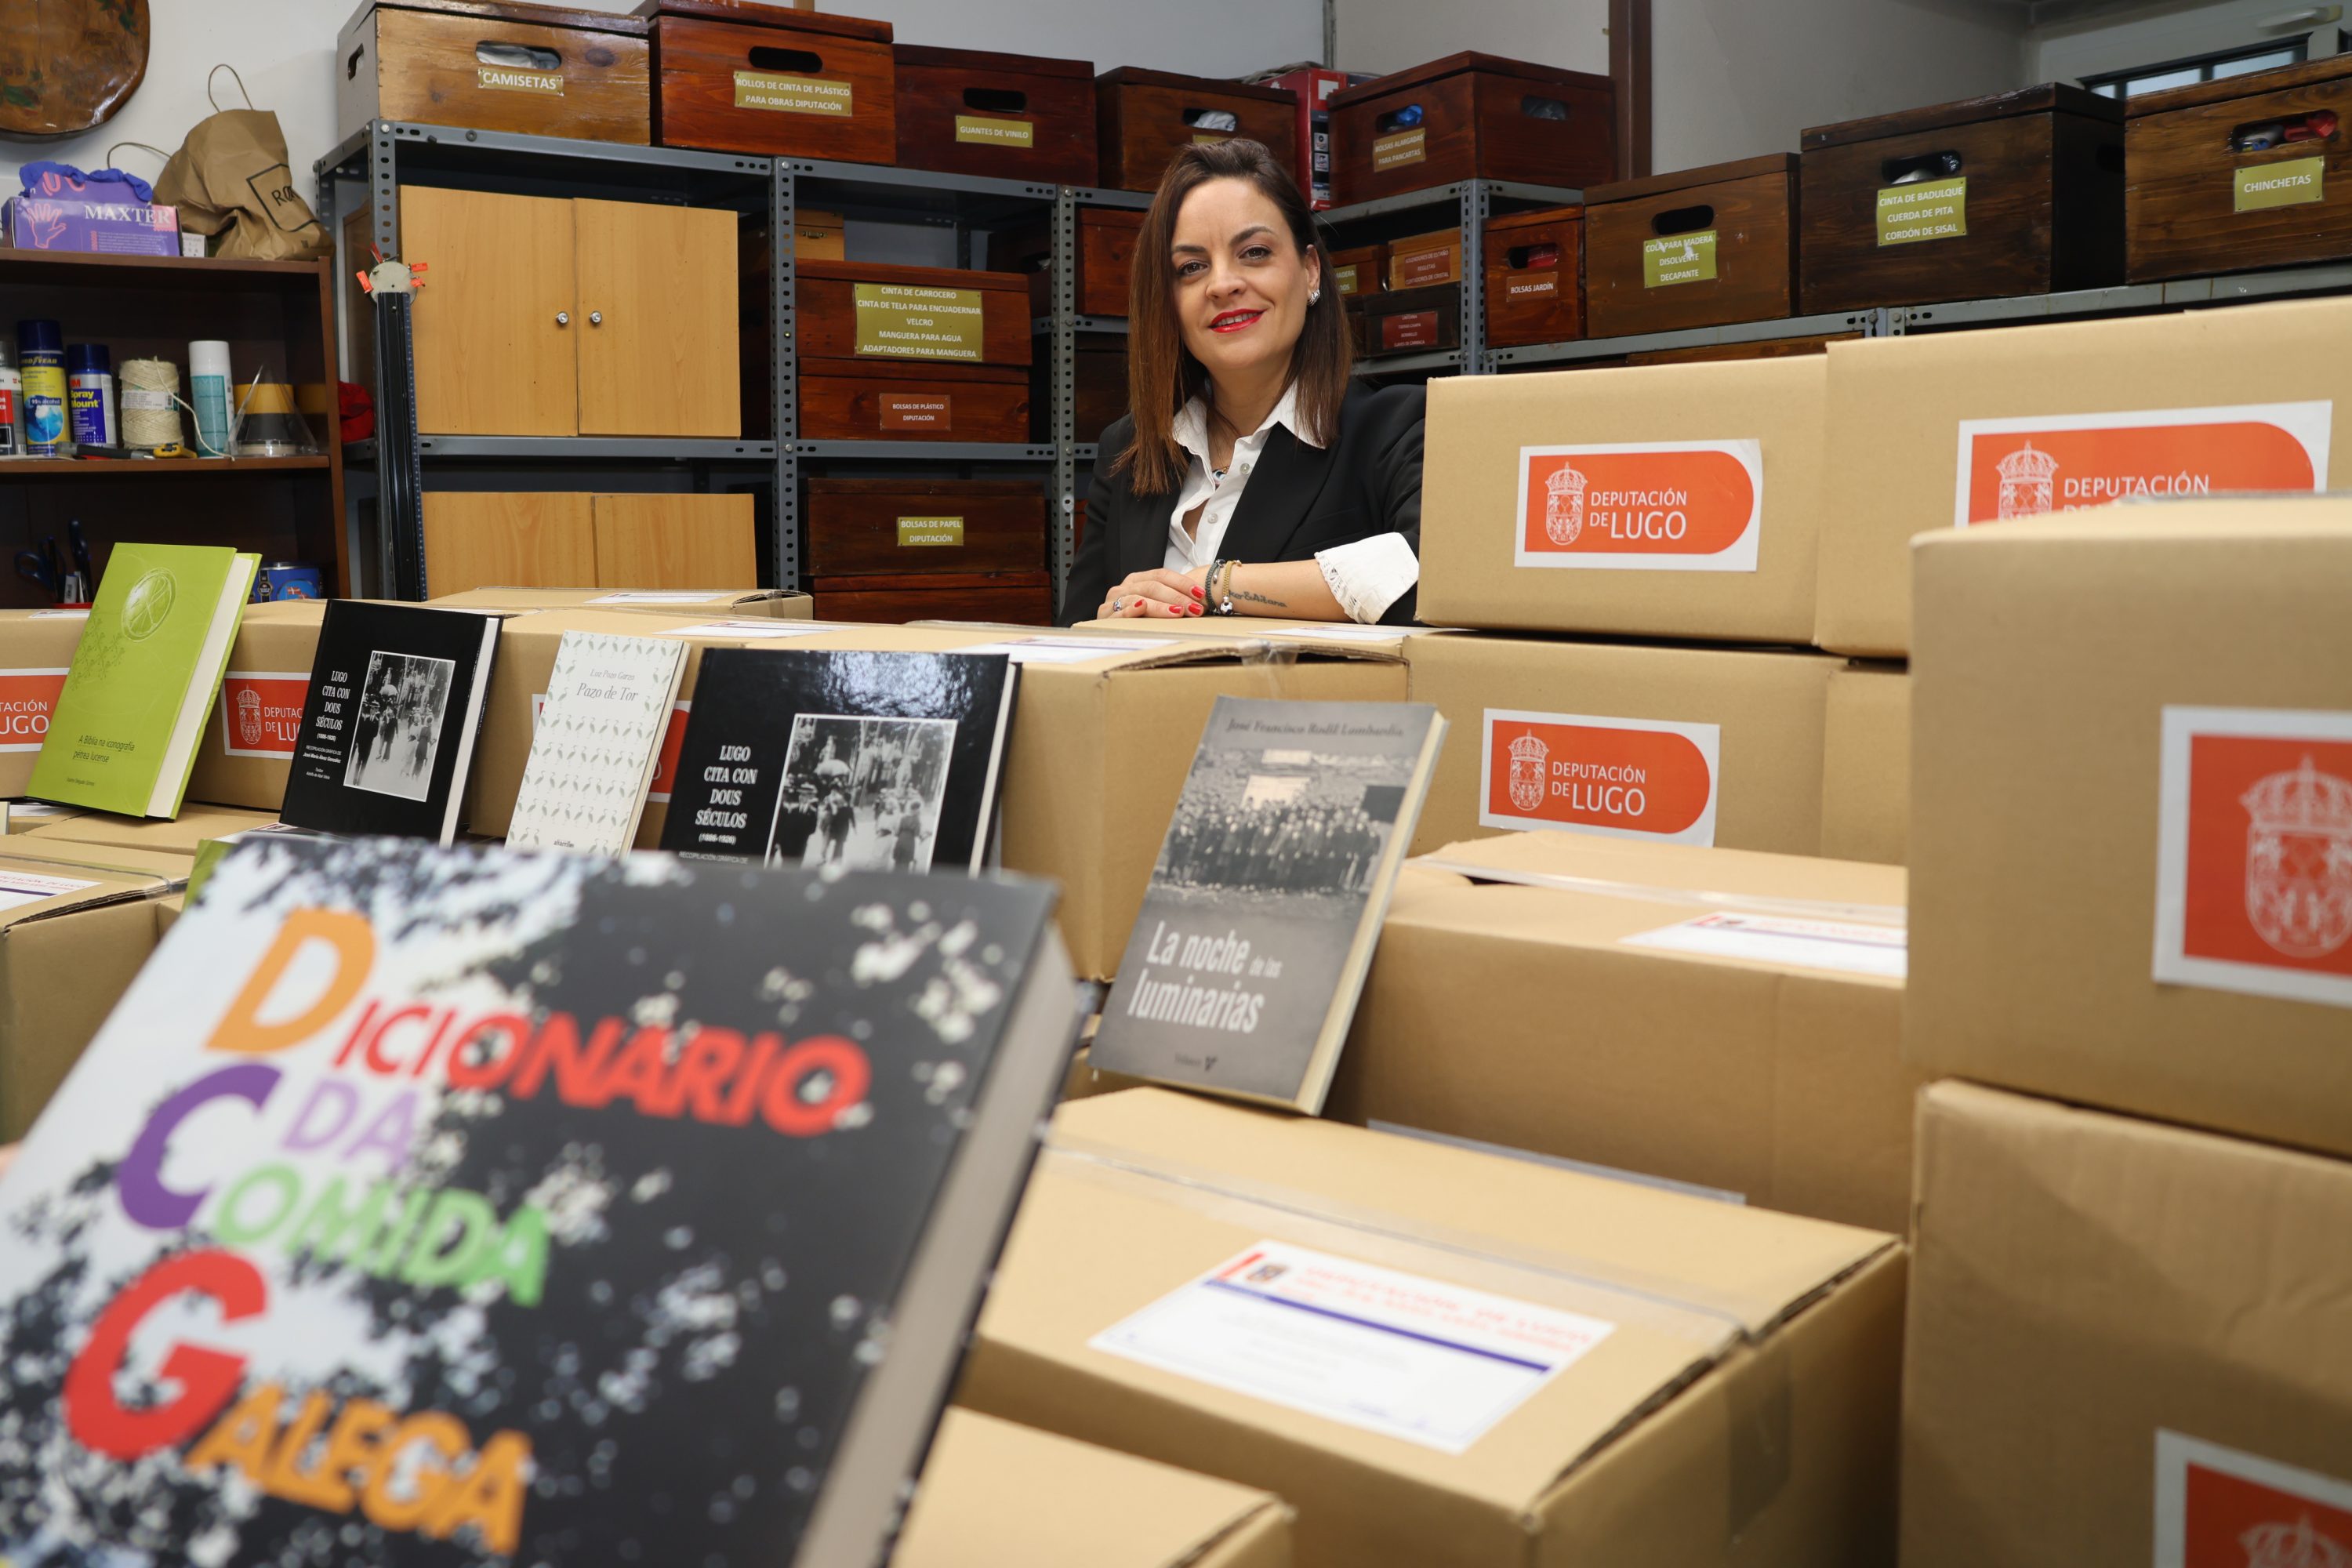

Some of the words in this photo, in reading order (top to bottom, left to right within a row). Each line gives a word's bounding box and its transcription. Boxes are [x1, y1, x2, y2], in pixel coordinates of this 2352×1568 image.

[483, 72, 557, 89] CAMISETAS
[737, 79, 765, 88] ROLLOS
[779, 83, 801, 92] CINTA
[815, 85, 850, 96] PLÁSTICO
[746, 95, 766, 104] PARA
[768, 97, 793, 107] OBRAS
[795, 100, 842, 111] DIPUTACIÓN
[960, 126, 993, 136] GUANTES
[2244, 174, 2311, 193] CHINCHETAS
[1879, 195, 1903, 207] CINTA
[1905, 194, 1915, 203] DE
[1918, 187, 1963, 201] BADULQUE
[84, 205, 172, 225] MAXTER
[1887, 211, 1921, 223] CUERDA
[1922, 209, 1933, 218] DE
[1935, 206, 1954, 216] PITA
[1886, 227, 1921, 241] CORDÓN
[1922, 227, 1933, 236] DE
[1935, 223, 1958, 234] SISAL
[1664, 239, 1682, 249] PARA
[1684, 235, 1713, 247] MADERA
[1659, 253, 1700, 267] DISOLVENTE
[1661, 269, 1699, 282] DECAPANTE
[915, 290, 956, 299] CARROCERO
[1511, 285, 1532, 294] BOLSAS
[1533, 281, 1554, 292] JARDÍN
[930, 305, 981, 314] ENCUADERNAR
[879, 331, 920, 340] MANGUERA
[863, 345, 915, 354] ADAPTADORES
[936, 349, 976, 358] MANGUERA
[2063, 470, 2210, 498] DEPUTACIÓN
[1591, 487, 1687, 507] DEPUTACIÓN
[1589, 512, 1609, 527] DE
[1610, 510, 1686, 539] LUGO
[909, 533, 953, 543] DIPUTACIÓN
[331, 670, 348, 683] LUGO
[322, 685, 336, 698] CITA
[337, 688, 350, 699] CON
[576, 682, 602, 698] Pazo
[604, 685, 617, 699] de
[619, 687, 639, 702] Tor
[264, 706, 303, 719] DEPUTAC
[324, 701, 341, 714] DOUS
[0, 714, 49, 735] UGO
[316, 715, 343, 730] SÉCULOS
[265, 721, 277, 732] DE
[278, 722, 301, 742] LU
[85, 735, 98, 746] Biblia
[99, 739, 106, 747] na
[106, 739, 135, 752] iconografía
[72, 750, 89, 760] pétrea
[90, 751, 110, 763] lucense
[719, 745, 751, 761] LUGO
[703, 766, 730, 782] CITA
[732, 768, 759, 785] CON
[1552, 761, 1646, 784] DEPUTACIÓN
[709, 788, 742, 806] DOUS
[1552, 781, 1570, 797] DE
[1573, 782, 1646, 816] LUGO
[695, 807, 748, 829] SÉCULOS
[1145, 920, 1181, 966] La
[1178, 928, 1251, 975] noche
[1248, 955, 1265, 977] de
[1263, 956, 1283, 978] las
[1127, 967, 1265, 1033] luminarias
[202, 906, 870, 1137] DICIONARIO
[280, 1078, 423, 1172] DA
[116, 1062, 549, 1306] COMIDA
[63, 1245, 532, 1555] GALEGA
